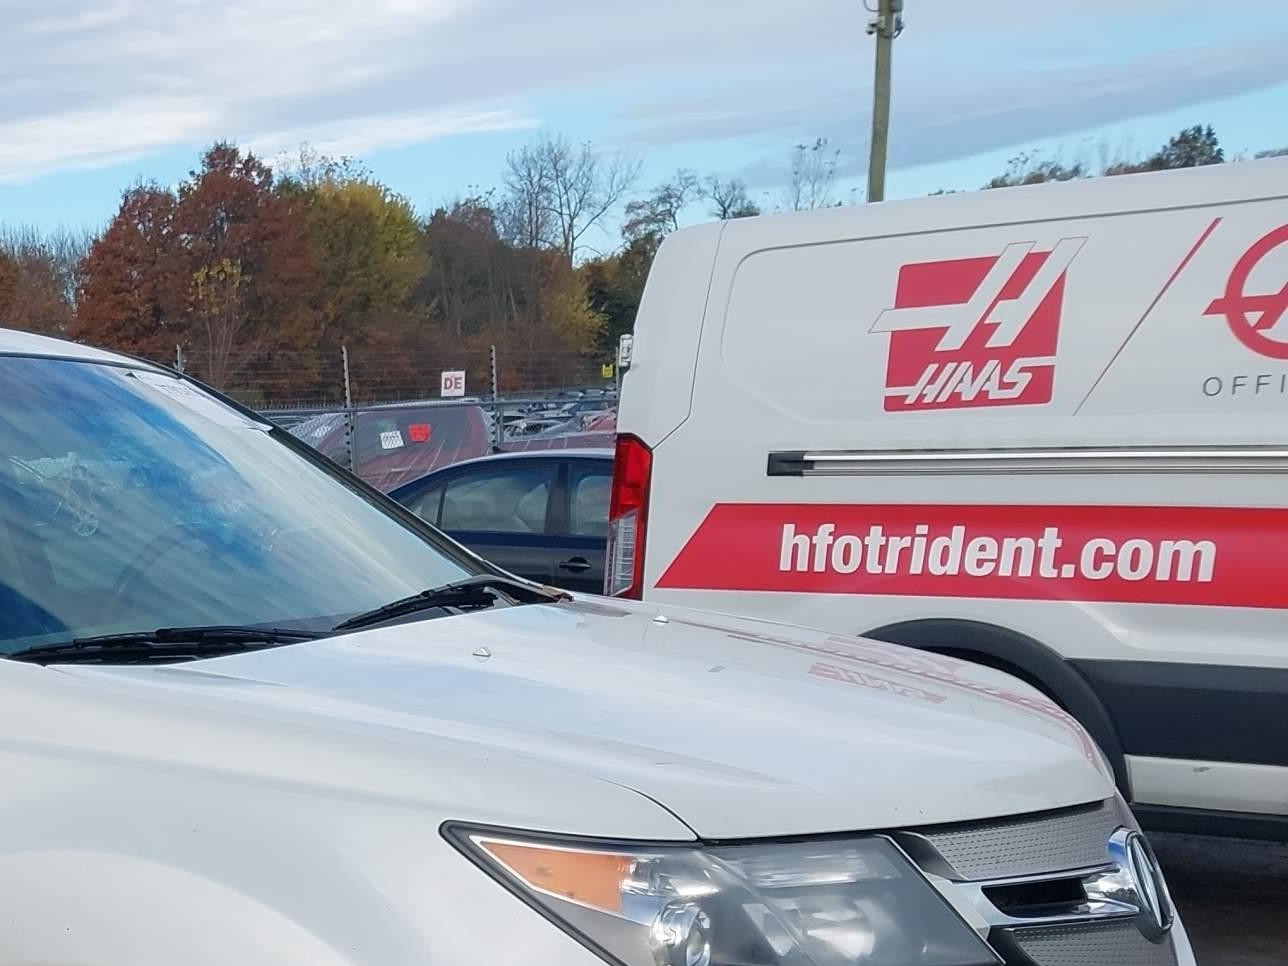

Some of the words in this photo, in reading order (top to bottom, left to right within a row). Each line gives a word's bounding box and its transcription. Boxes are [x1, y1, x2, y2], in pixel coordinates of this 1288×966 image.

[444, 377, 463, 390] DE
[886, 356, 1056, 405] HAAS
[779, 523, 1217, 582] hfotrident.com
